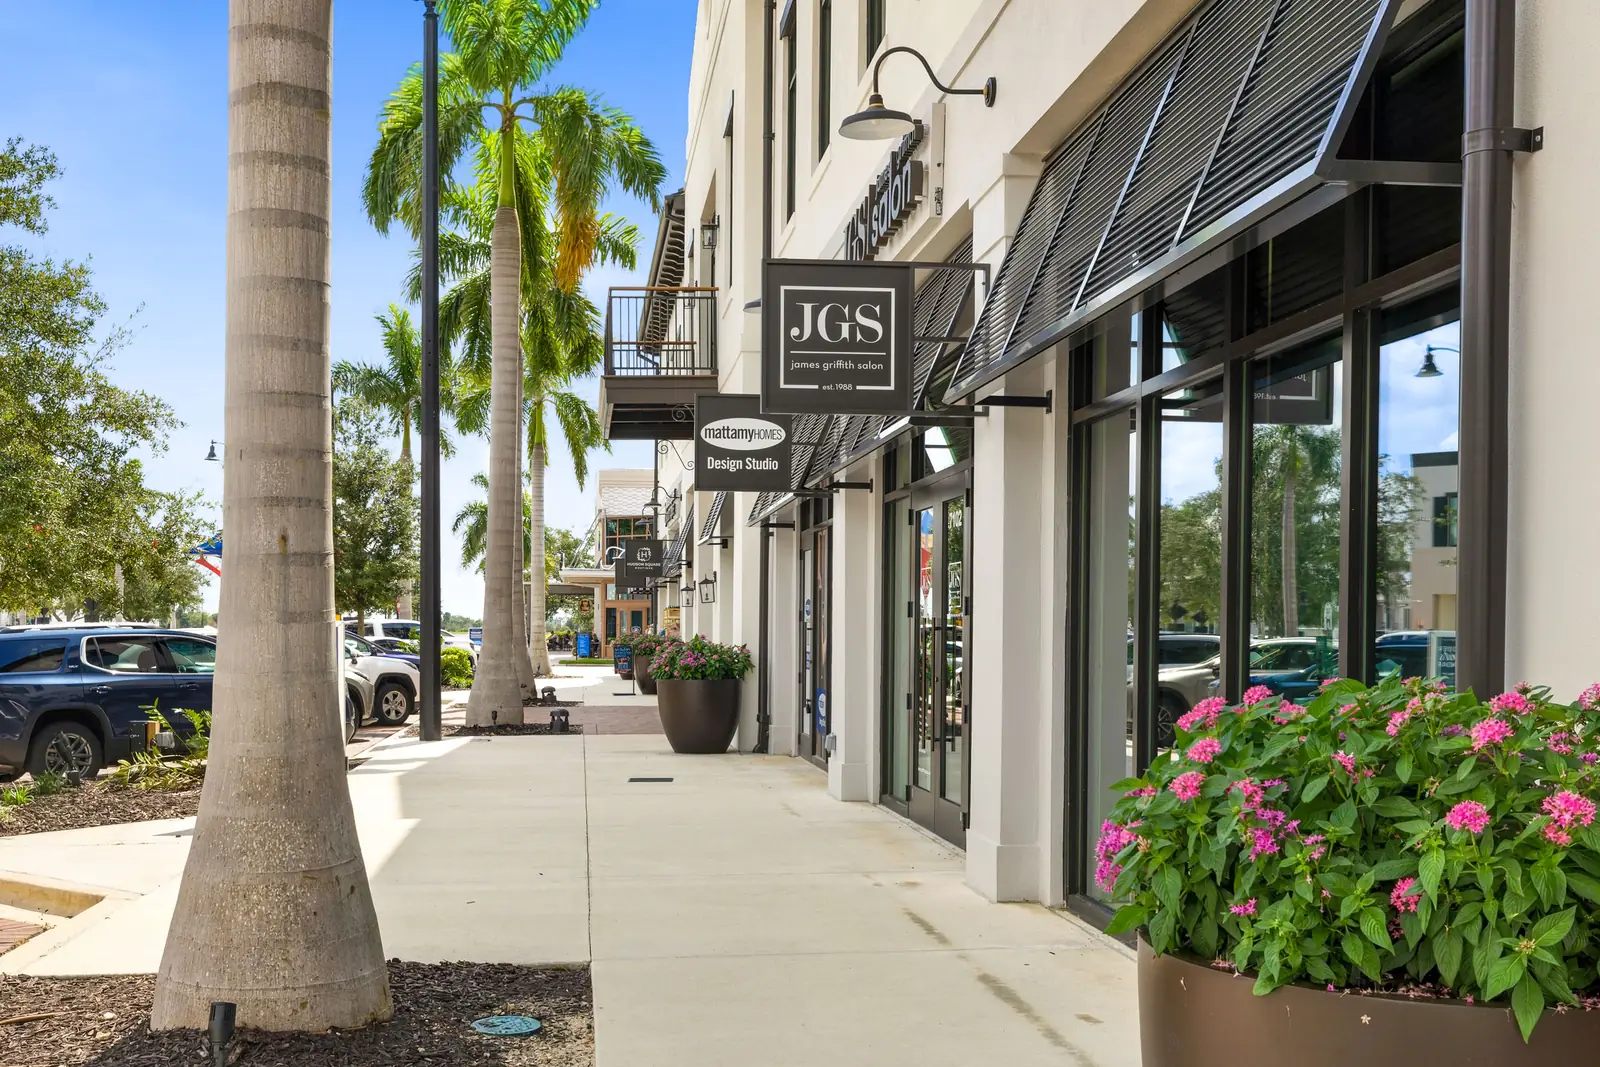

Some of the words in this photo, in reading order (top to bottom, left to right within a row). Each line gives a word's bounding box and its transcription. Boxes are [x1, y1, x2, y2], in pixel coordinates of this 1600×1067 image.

[871, 151, 914, 248] salon
[790, 302, 884, 344] JGS
[790, 360, 820, 371] james
[822, 359, 855, 371] griffith
[857, 360, 884, 370] salon
[822, 383, 853, 391] est.1988
[707, 456, 743, 472] Design
[745, 457, 779, 471] Studio
